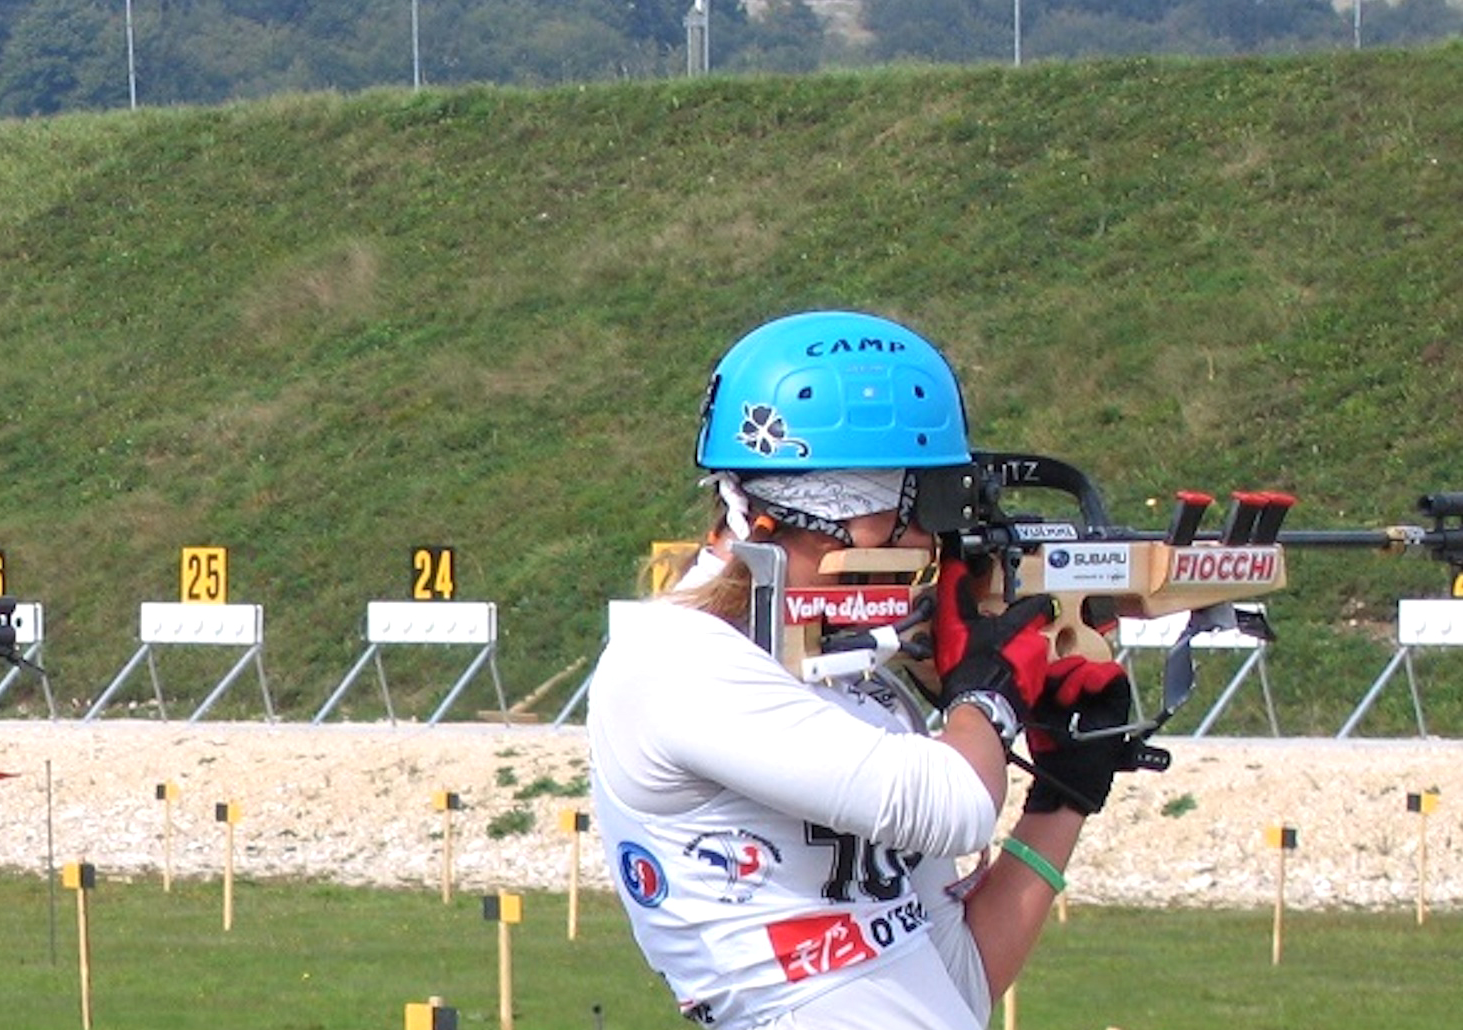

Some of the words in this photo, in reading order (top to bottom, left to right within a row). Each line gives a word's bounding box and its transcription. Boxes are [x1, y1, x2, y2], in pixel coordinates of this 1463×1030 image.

[806, 338, 906, 358] CAMP
[1074, 552, 1126, 566] SUBARU
[1173, 552, 1275, 582] FIOCCHI
[188, 554, 220, 600] 25
[413, 549, 453, 600] 24
